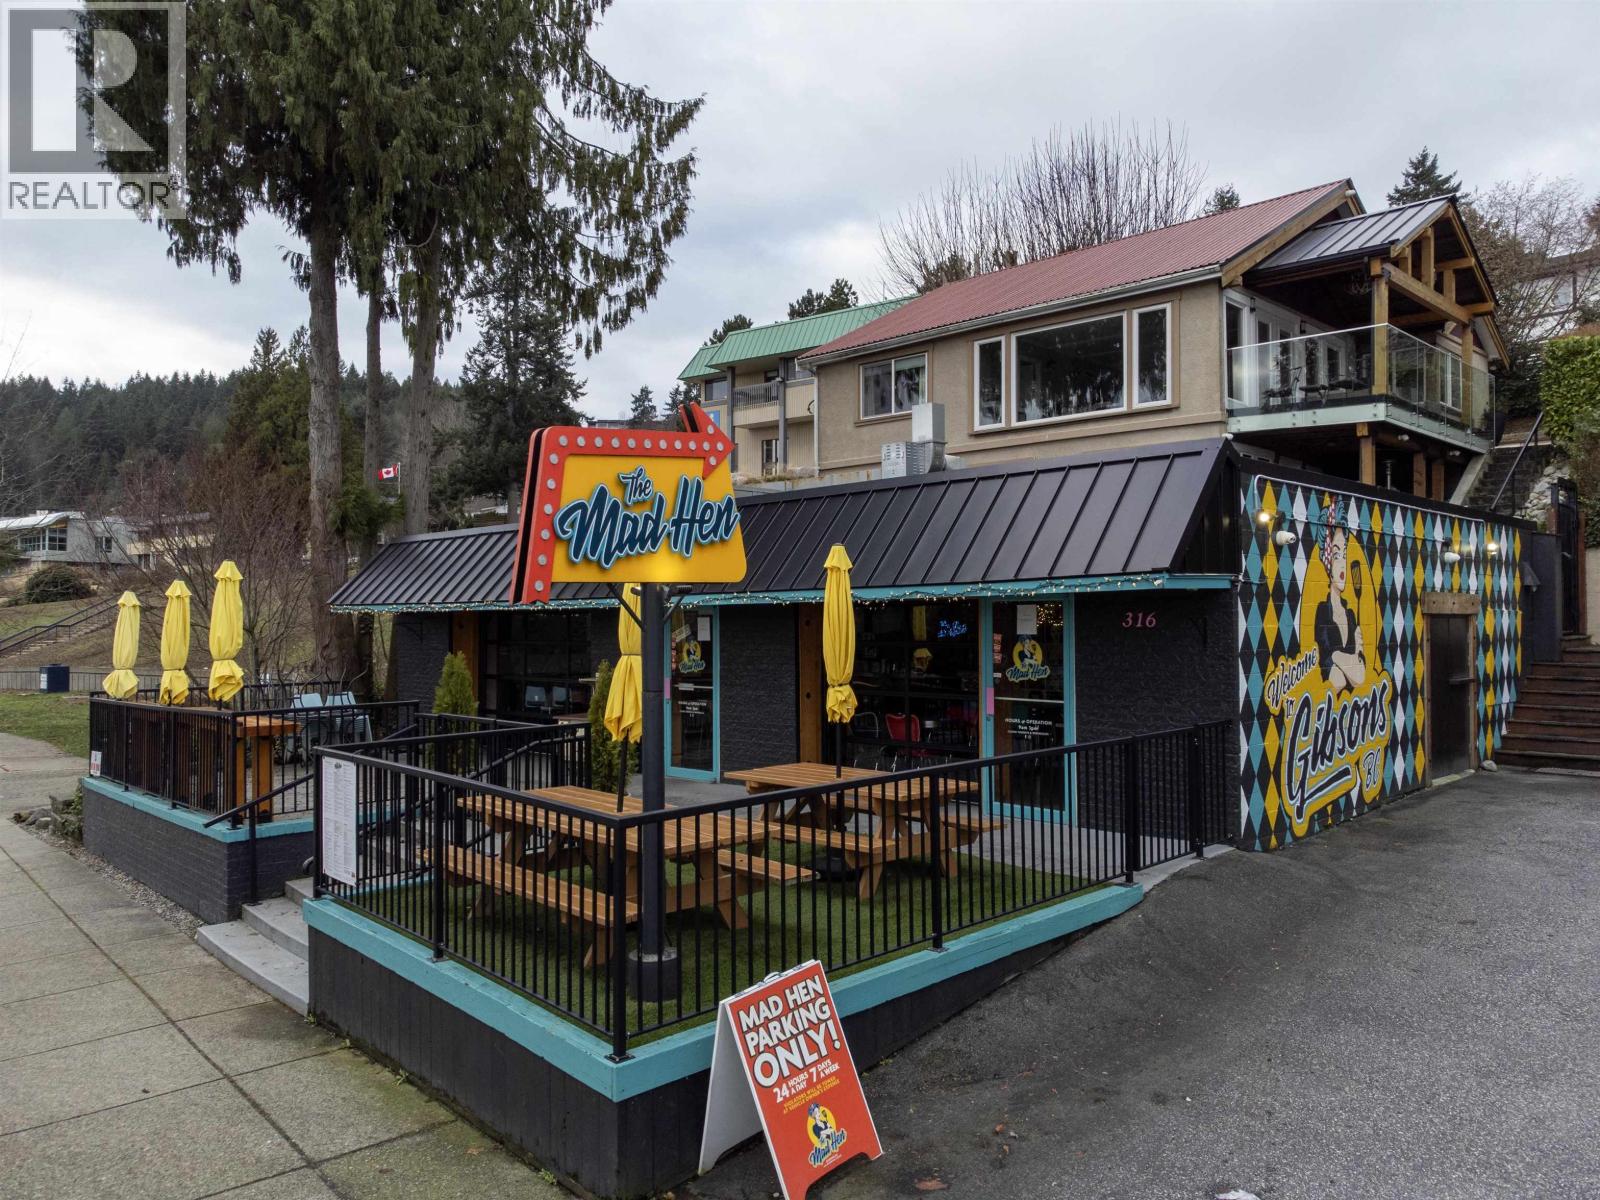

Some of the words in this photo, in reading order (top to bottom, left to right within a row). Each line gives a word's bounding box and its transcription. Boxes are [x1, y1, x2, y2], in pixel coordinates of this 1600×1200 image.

[618, 465, 653, 506] The
[554, 484, 668, 570] Mad
[669, 475, 741, 558] Hen
[1122, 611, 1157, 628] 316
[1266, 648, 1318, 710] Welcome
[1286, 678, 1390, 823] Gibsons
[1363, 748, 1381, 793] BC
[738, 995, 784, 1033] MAD
[784, 974, 824, 1010] HEN
[744, 996, 831, 1057] PARKING
[753, 1018, 841, 1088] ONLY!
[824, 1062, 841, 1075] WEEK
[773, 1082, 790, 1104] 24
[788, 1071, 809, 1087] HOURS
[809, 1066, 817, 1083] 7
[817, 1058, 832, 1071] DAYS
[791, 1087, 797, 1095] A
[796, 1080, 807, 1092] DAY
